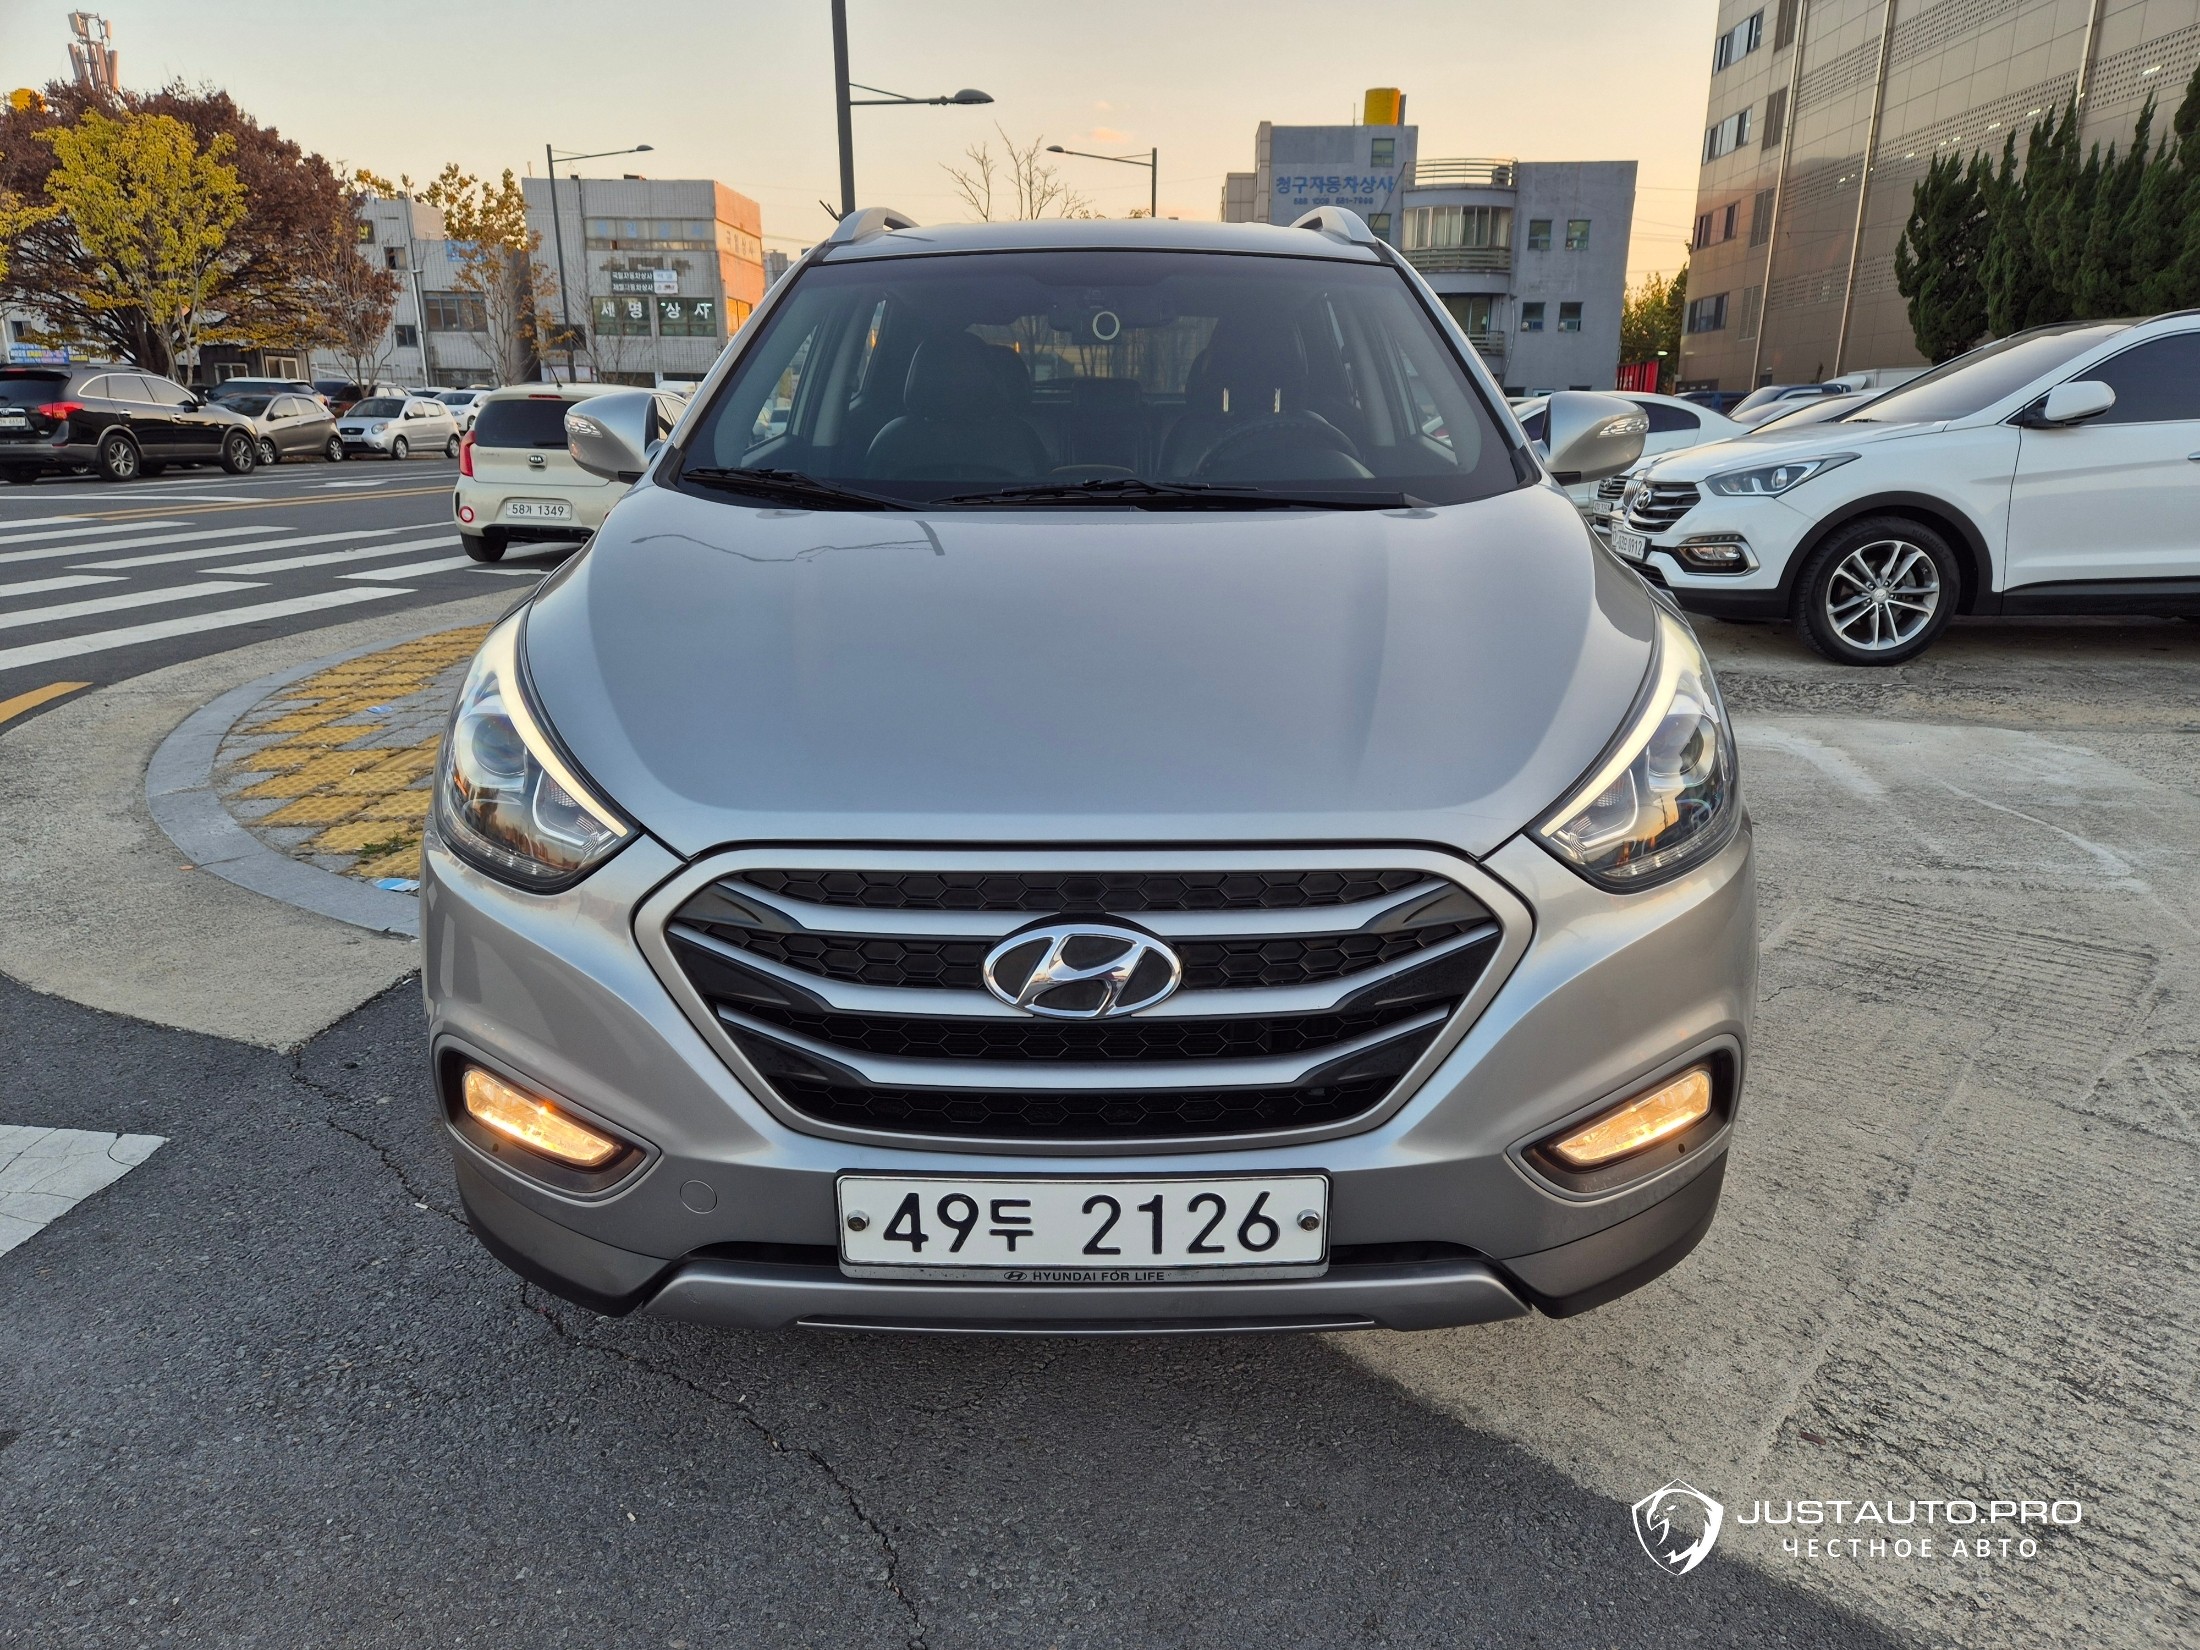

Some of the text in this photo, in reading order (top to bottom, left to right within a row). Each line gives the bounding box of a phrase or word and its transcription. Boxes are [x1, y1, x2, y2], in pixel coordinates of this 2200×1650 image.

[1276, 175, 1394, 194] 청구자동차상사
[538, 504, 564, 516] 1349
[883, 1190, 1281, 1255] 49두 2126
[1033, 1271, 1165, 1281] HYUNDAI FOR LIFE
